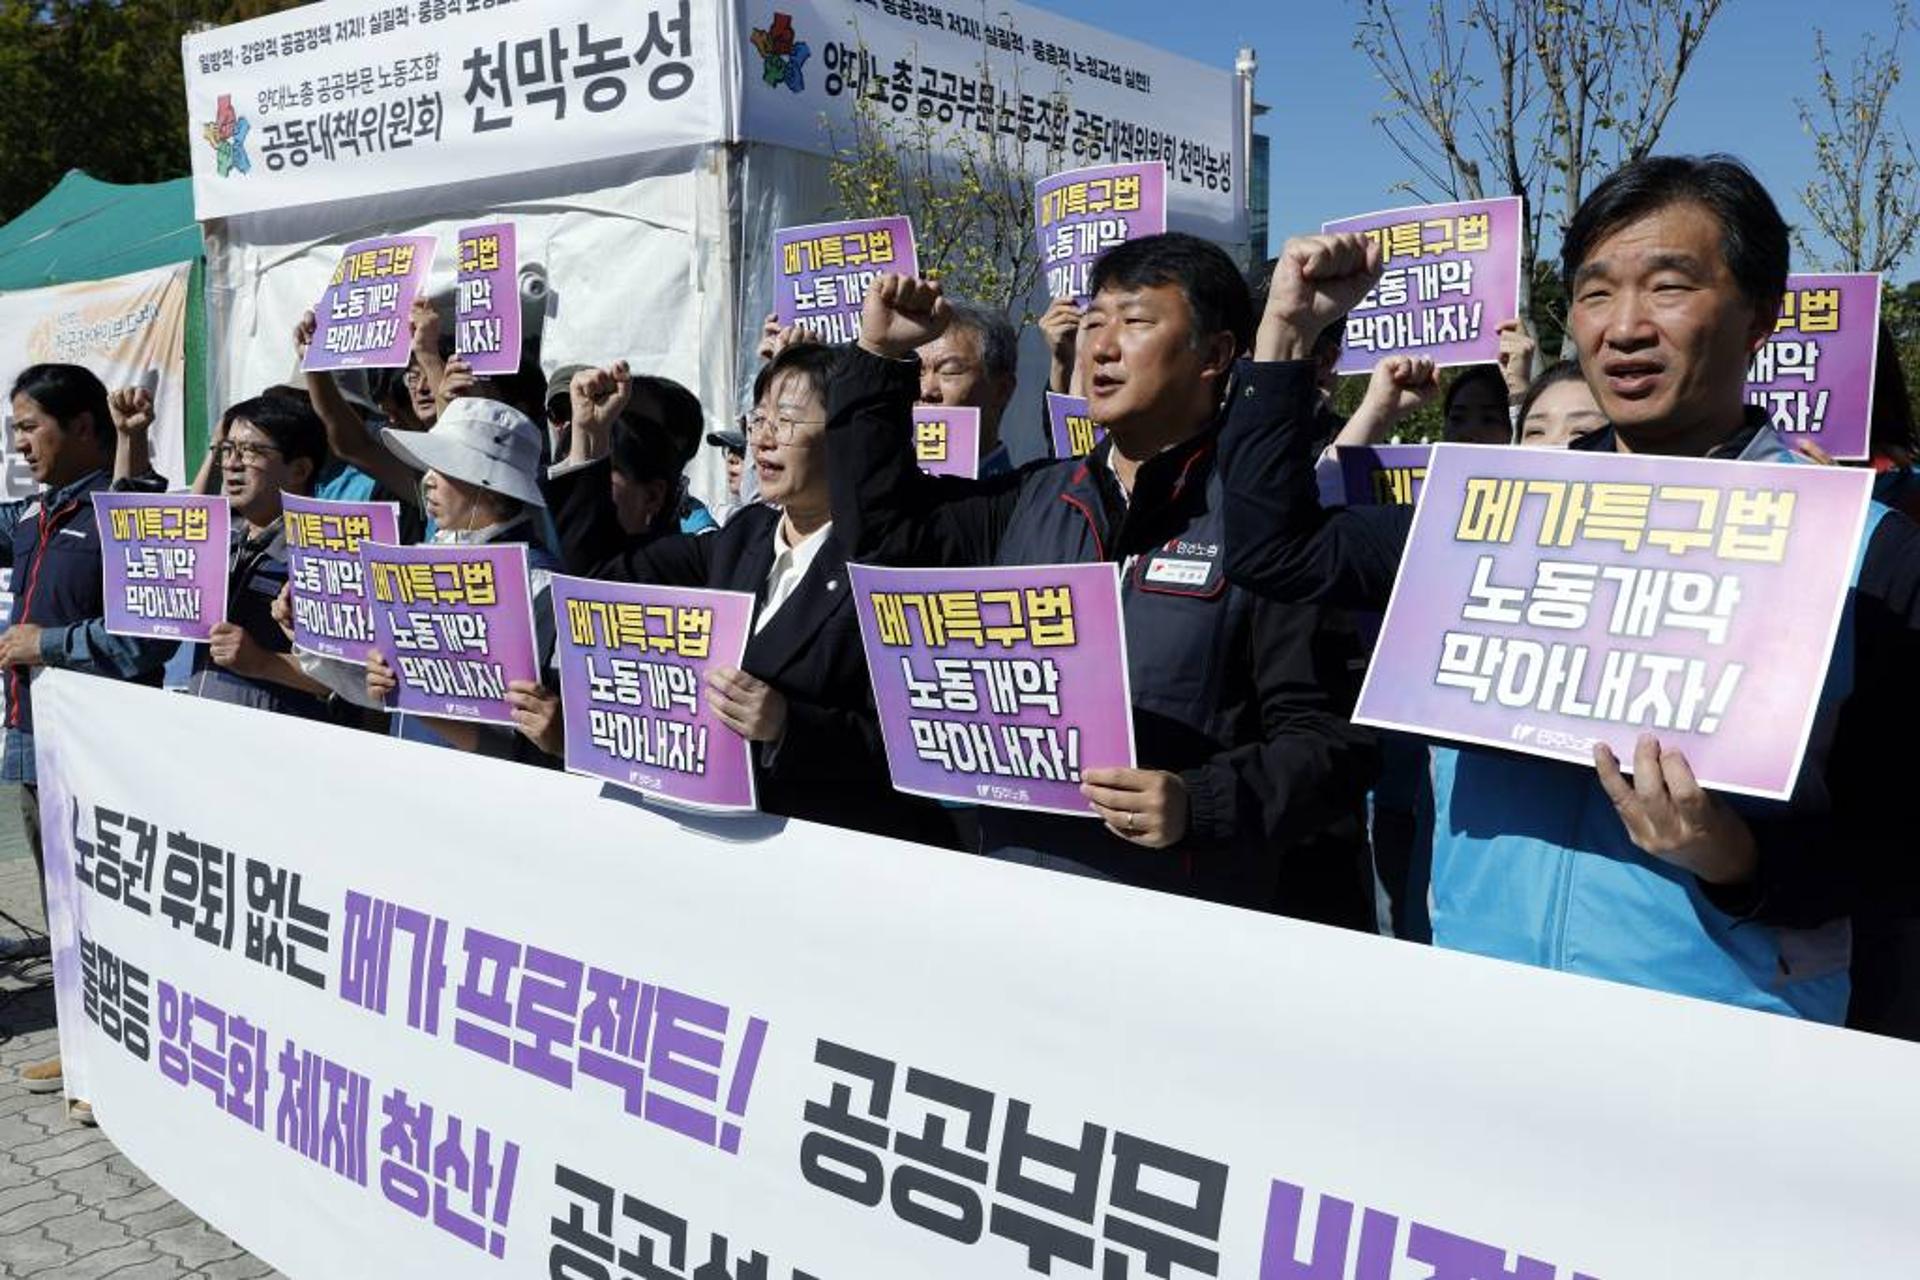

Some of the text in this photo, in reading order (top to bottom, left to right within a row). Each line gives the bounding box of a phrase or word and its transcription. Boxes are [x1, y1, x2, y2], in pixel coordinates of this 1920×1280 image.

[280, 23, 332, 56] 공공정책
[335, 16, 365, 42] 저지!
[947, 12, 981, 41] 저지!
[1124, 67, 1151, 94] 실현!
[258, 51, 441, 115] 양대노총 공공부문 노동조합
[462, 0, 694, 133] 천막농성
[261, 91, 444, 171] 공동대책위원회
[824, 42, 912, 113] 양대노총
[917, 66, 995, 134] 공공부문
[1178, 139, 1232, 194] 천막농성
[783, 229, 895, 276] 메가특구법
[1365, 213, 1490, 264] 가특구법
[331, 282, 399, 320] 노동개악
[1345, 302, 1484, 352] 막아내자!
[324, 318, 400, 354] 막아내자!
[109, 506, 209, 541] 메가특구법
[1454, 477, 1798, 565] 메가특구법
[124, 546, 197, 581] 노동개악
[291, 554, 366, 597] 노동개악
[370, 560, 497, 606] 메가특구법
[125, 584, 202, 622] 막아내자!
[294, 594, 376, 643] 막아내자!
[566, 598, 713, 659] 메가특구법
[869, 586, 1077, 648] 메가특구법
[1461, 555, 1742, 646] 노동개악
[388, 610, 490, 656] 노동개악
[397, 655, 507, 701] 막아내자!
[585, 654, 698, 716] 노동개악
[900, 656, 1062, 716] 노동개악
[1434, 630, 1745, 736] 막아내자!
[588, 708, 708, 777] 막아내자!
[909, 718, 1081, 783] 막아내자!
[73, 795, 158, 917] 노동권
[160, 831, 236, 951] 후퇴
[245, 857, 331, 991] 없는
[339, 888, 450, 1037] 메가
[454, 926, 769, 1156] 프로젝트!
[800, 1037, 1231, 1280] 공공부문
[79, 929, 151, 1063] 불평등
[157, 979, 270, 1133] 양극화
[276, 1038, 372, 1188] 체제
[379, 1087, 521, 1261] 청산!
